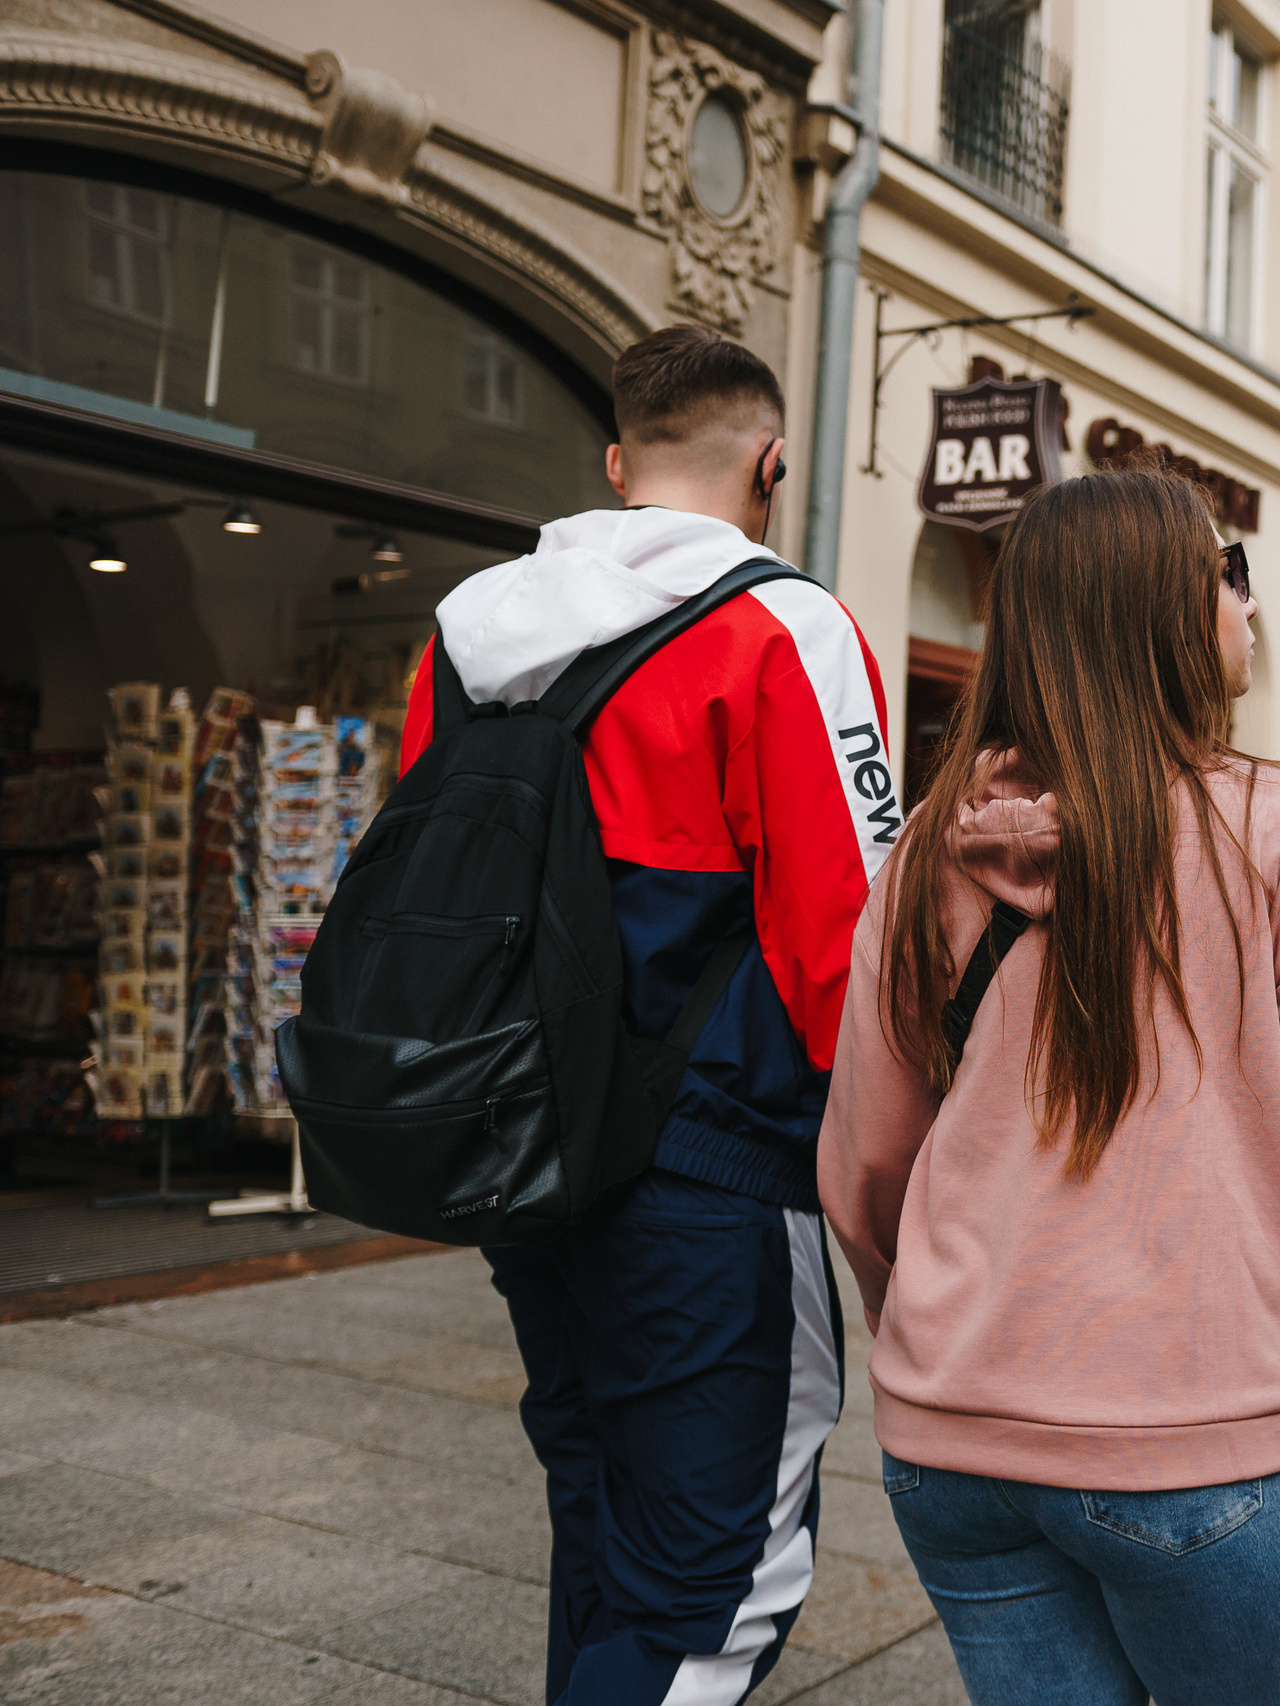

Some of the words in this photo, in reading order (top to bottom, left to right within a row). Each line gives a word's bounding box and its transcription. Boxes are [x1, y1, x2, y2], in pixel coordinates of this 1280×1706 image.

[935, 434, 1032, 485] BAR
[838, 722, 902, 844] new
[440, 1194, 499, 1220] HARVEST
